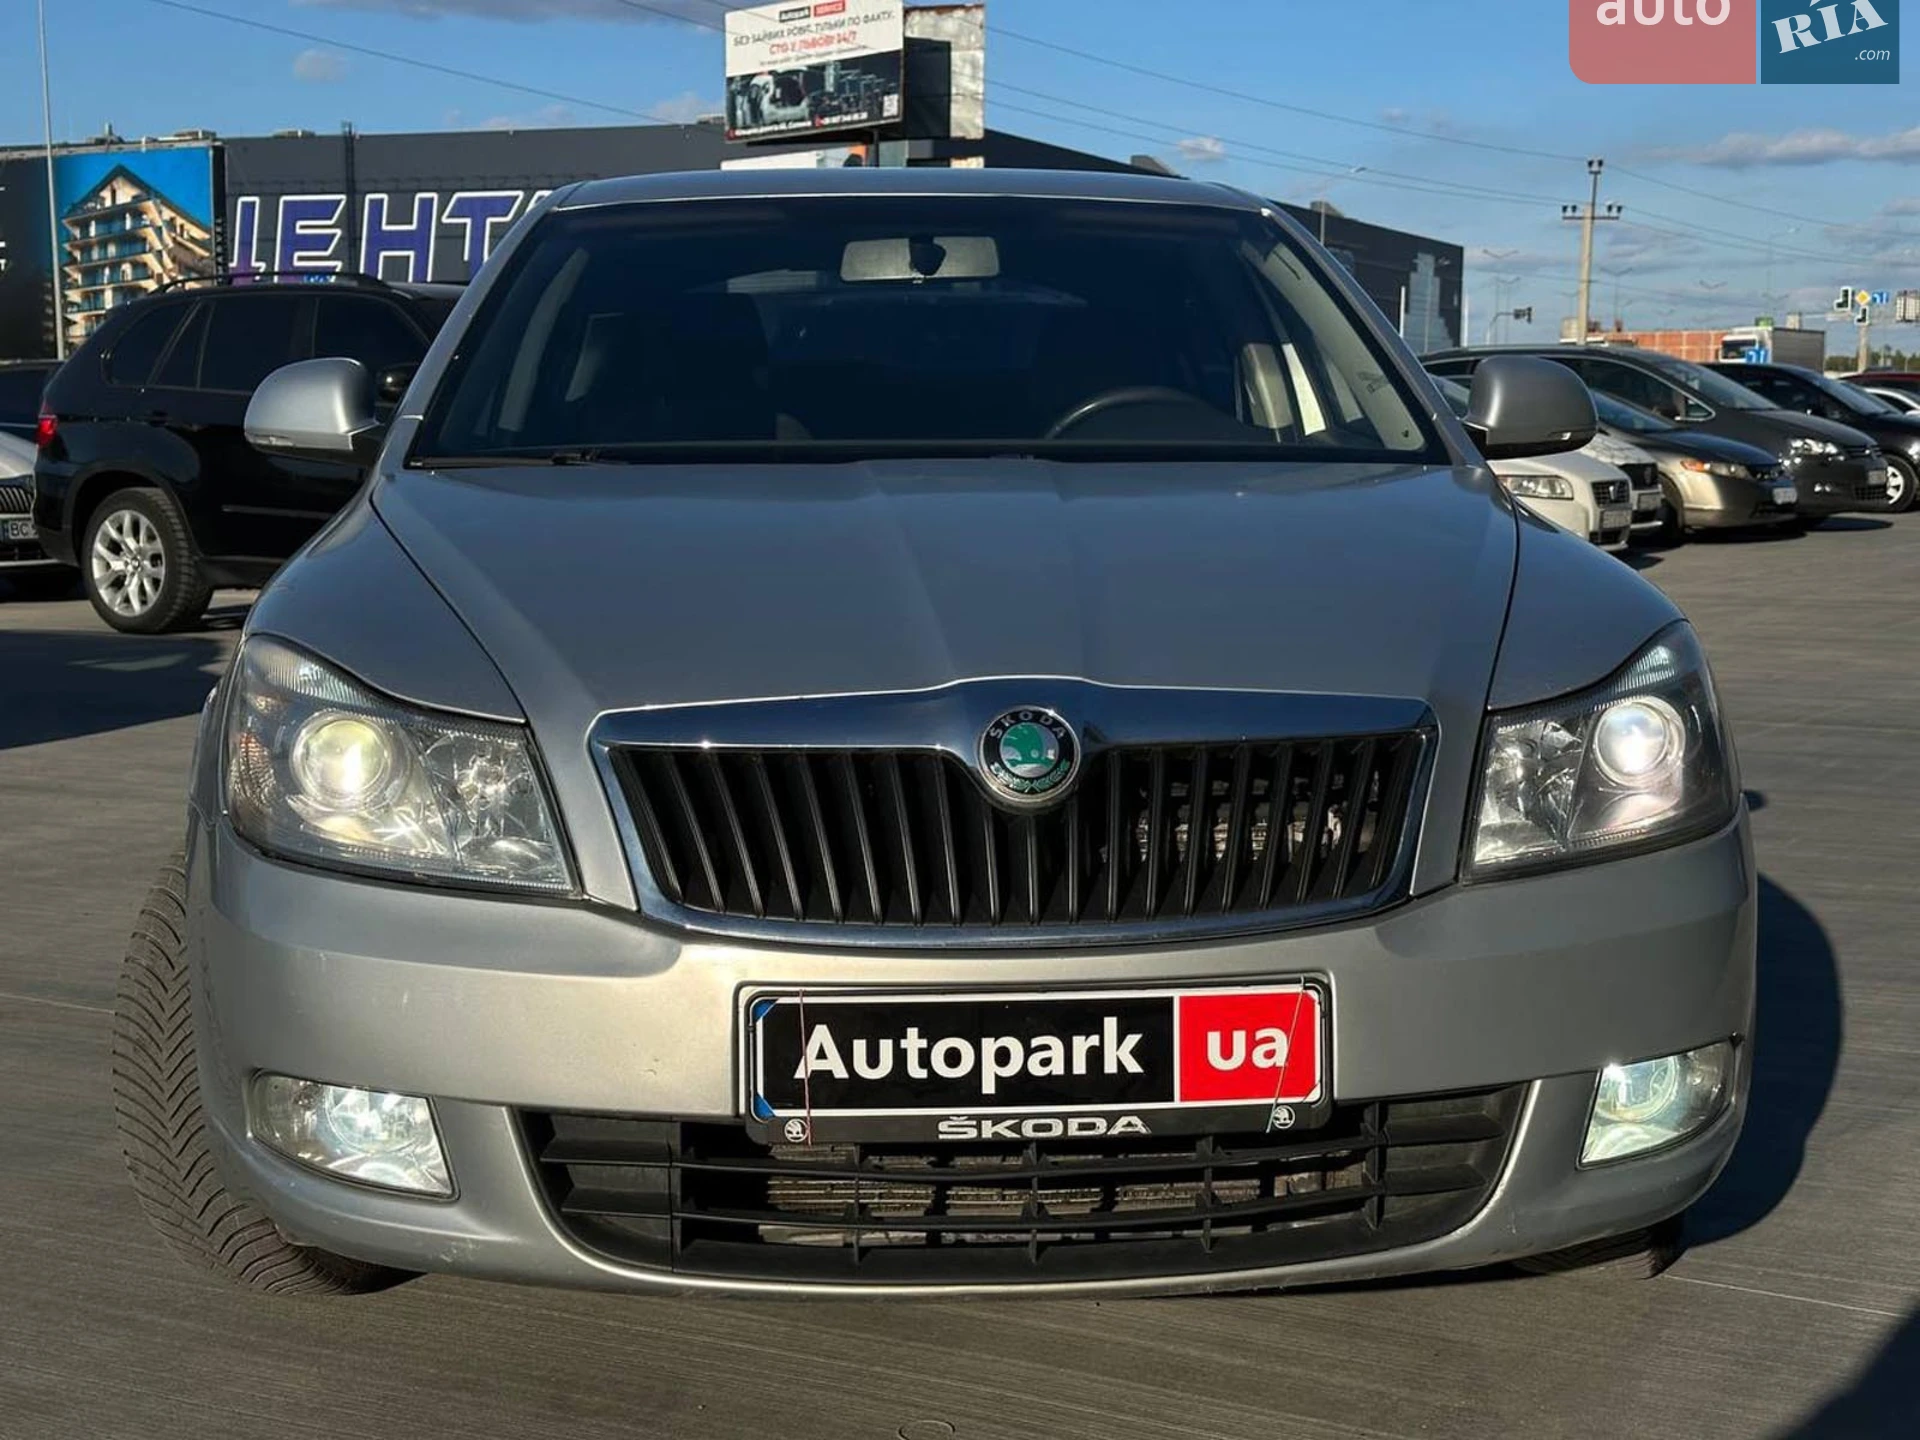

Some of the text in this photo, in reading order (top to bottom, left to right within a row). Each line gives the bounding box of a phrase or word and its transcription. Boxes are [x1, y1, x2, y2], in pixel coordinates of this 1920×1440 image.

[847, 17, 861, 27] ПО
[769, 44, 789, 54] СТО
[836, 31, 857, 44] 24/7
[793, 1015, 1290, 1095] Autopark ua
[937, 1114, 1152, 1140] ŠKODA
